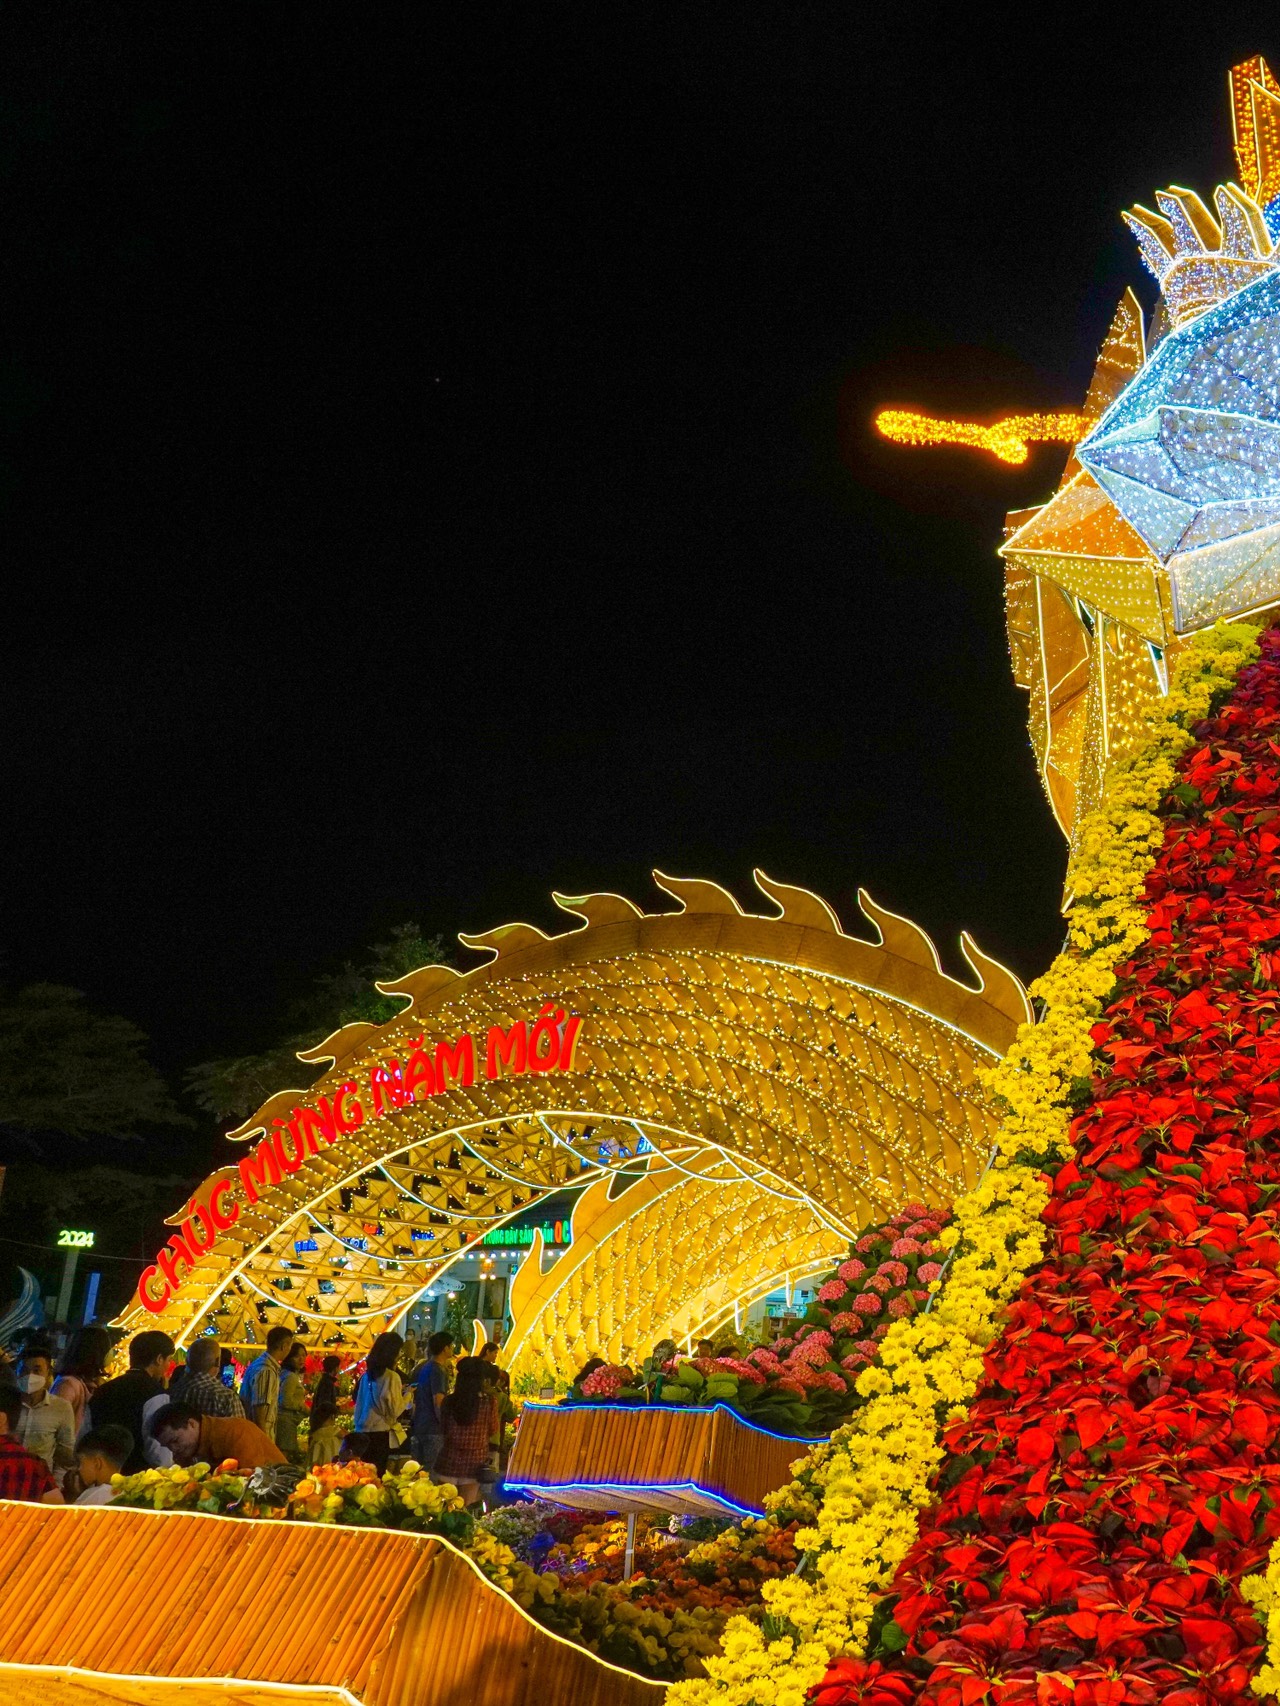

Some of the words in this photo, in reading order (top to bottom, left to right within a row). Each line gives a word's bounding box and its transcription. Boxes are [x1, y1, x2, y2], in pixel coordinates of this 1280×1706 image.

[57, 1230, 94, 1247] 2024
[137, 1178, 240, 1314] CHÚC
[238, 1081, 365, 1205] MỪNG
[370, 1033, 475, 1117] NĂM
[486, 1002, 582, 1080] MỚI
